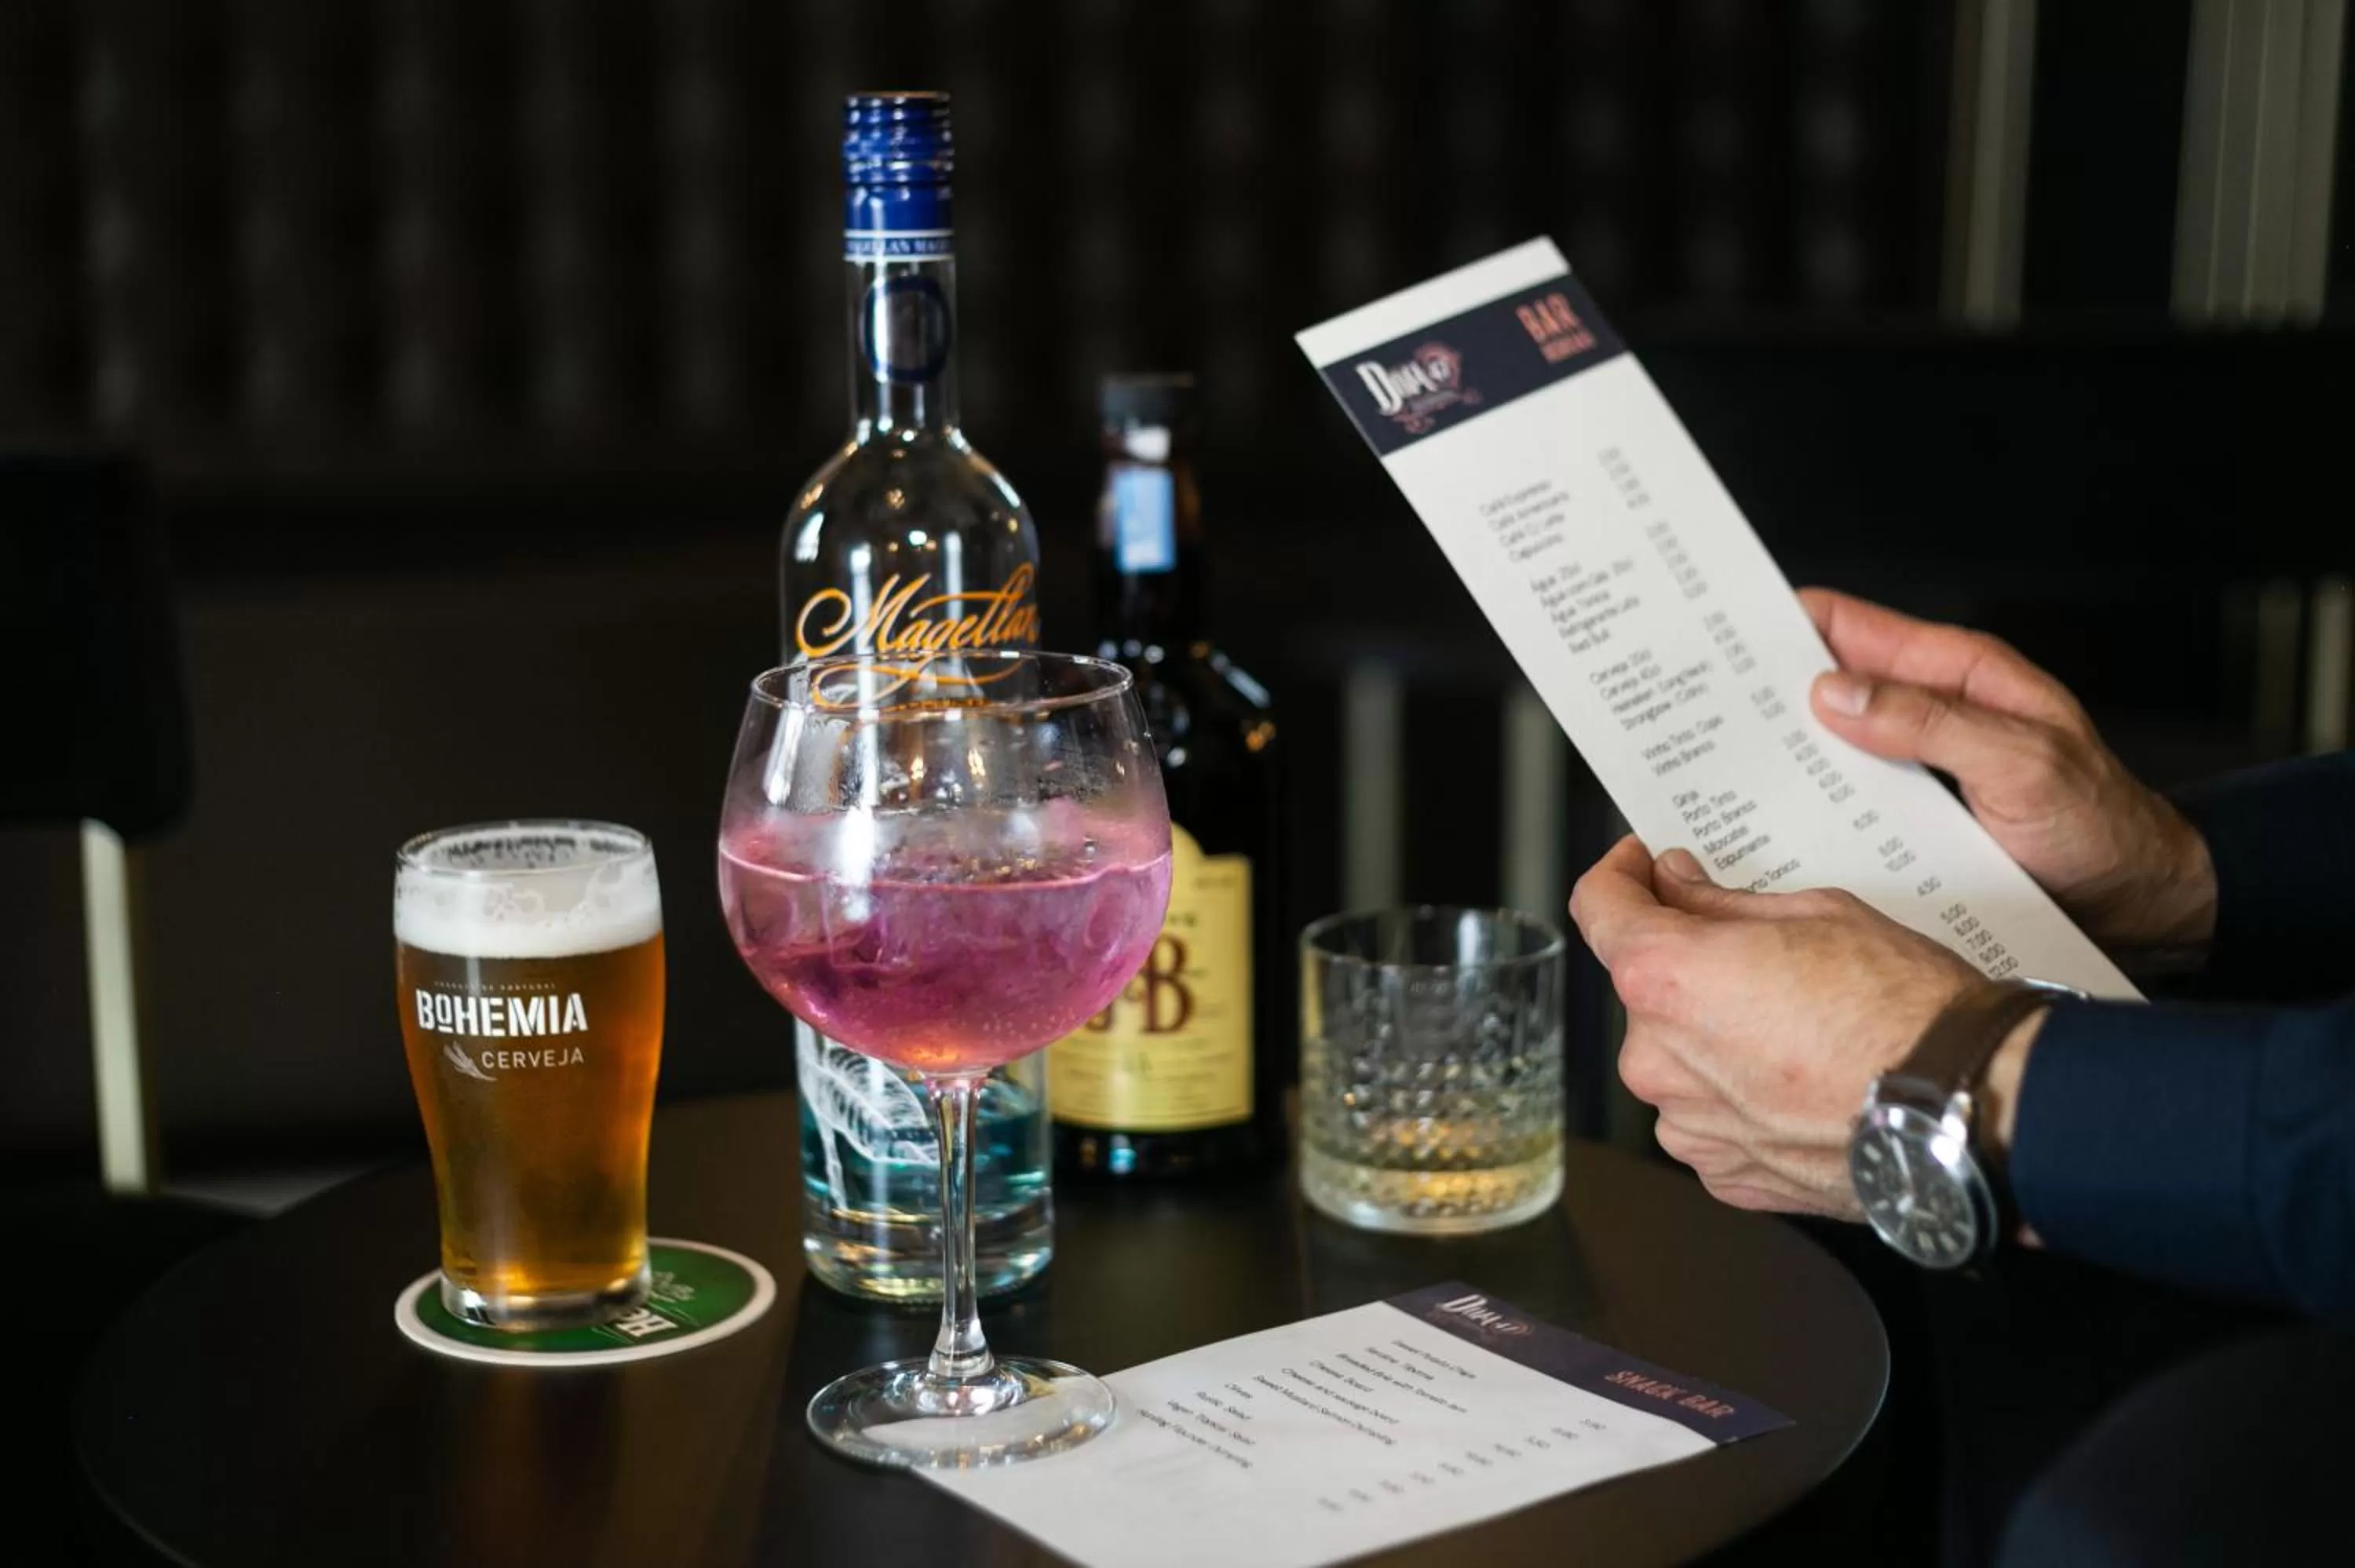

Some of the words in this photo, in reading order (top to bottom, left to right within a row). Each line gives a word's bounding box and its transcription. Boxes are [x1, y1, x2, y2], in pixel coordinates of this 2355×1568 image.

[1516, 293, 1581, 340] BAR
[415, 988, 589, 1037] BOHEMIA
[480, 1046, 585, 1069] CERVEJA
[1605, 1370, 1687, 1400] SNACK
[1679, 1394, 1735, 1419] BAR
